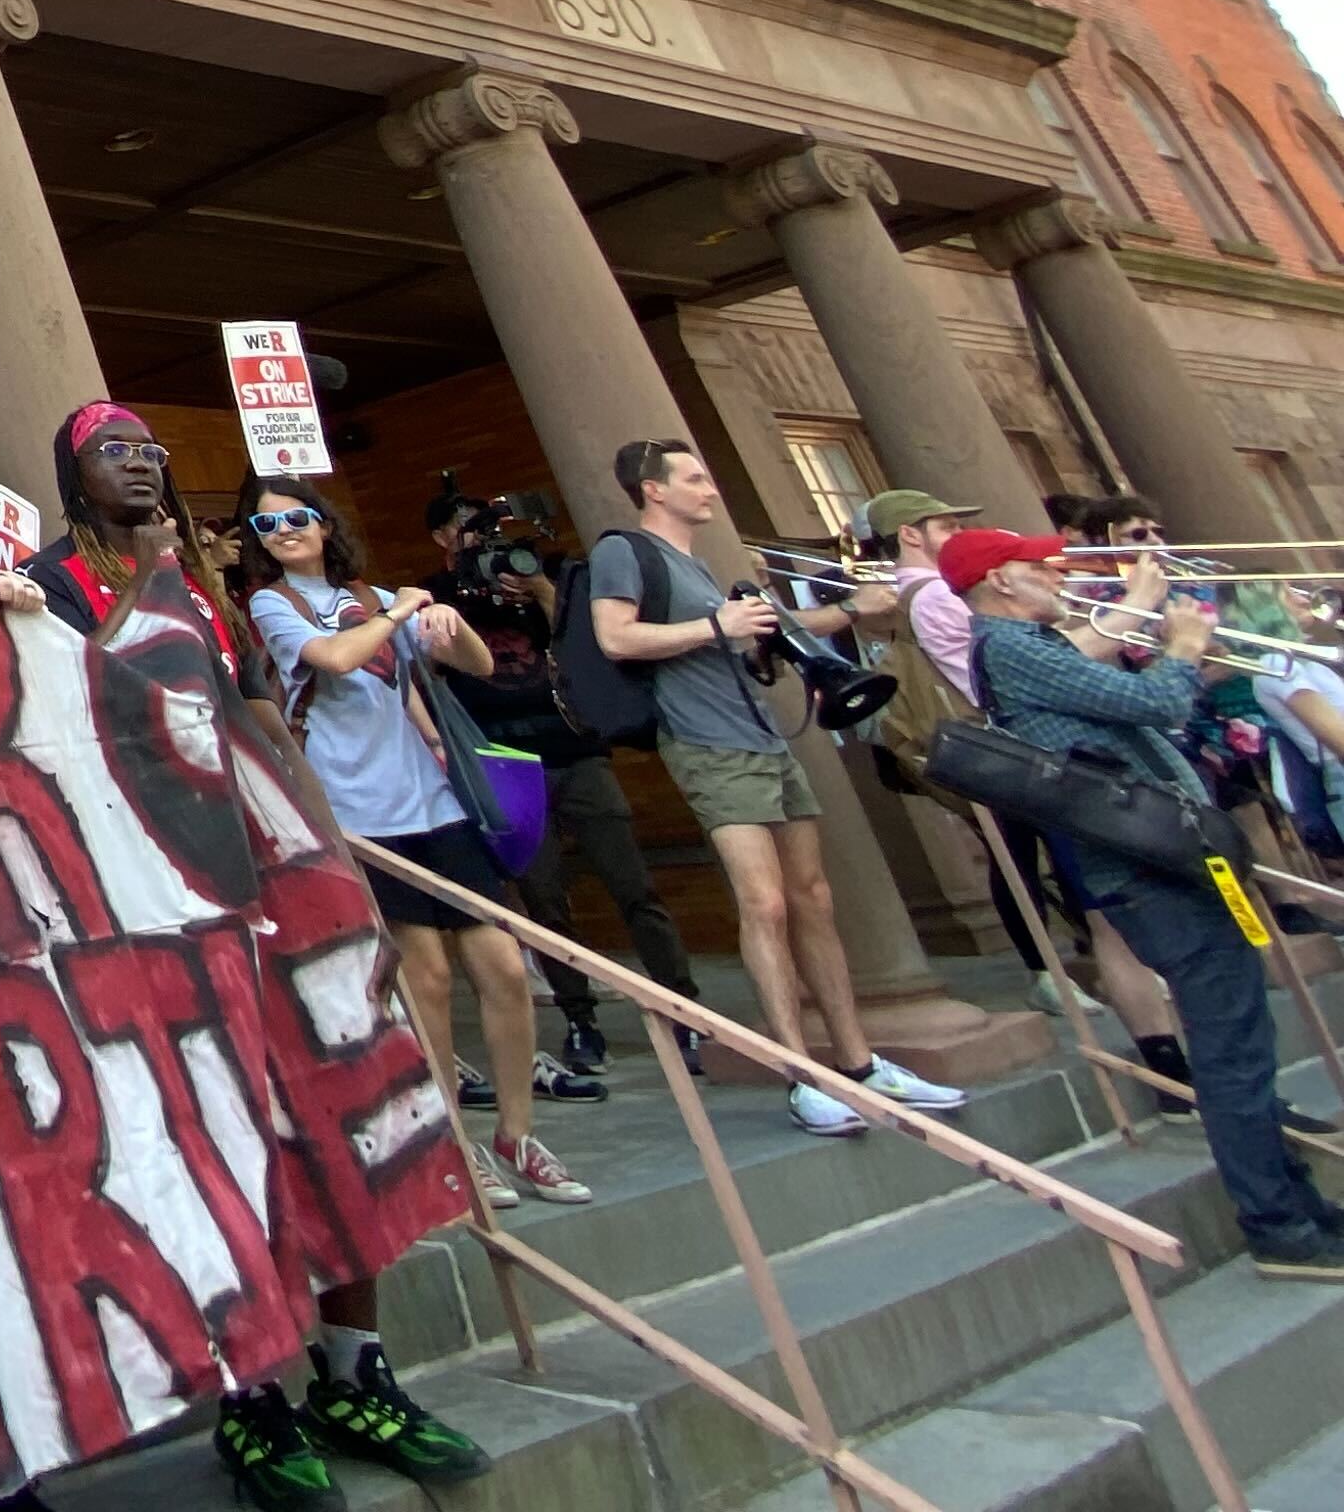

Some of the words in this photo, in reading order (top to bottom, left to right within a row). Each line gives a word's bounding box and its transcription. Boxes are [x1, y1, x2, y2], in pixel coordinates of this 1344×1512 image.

[243, 335, 270, 350] WE
[269, 331, 287, 352] R
[259, 360, 286, 381] ON
[240, 382, 310, 405] STRIKE
[252, 423, 299, 435] STUDENTS
[3, 500, 21, 536] R
